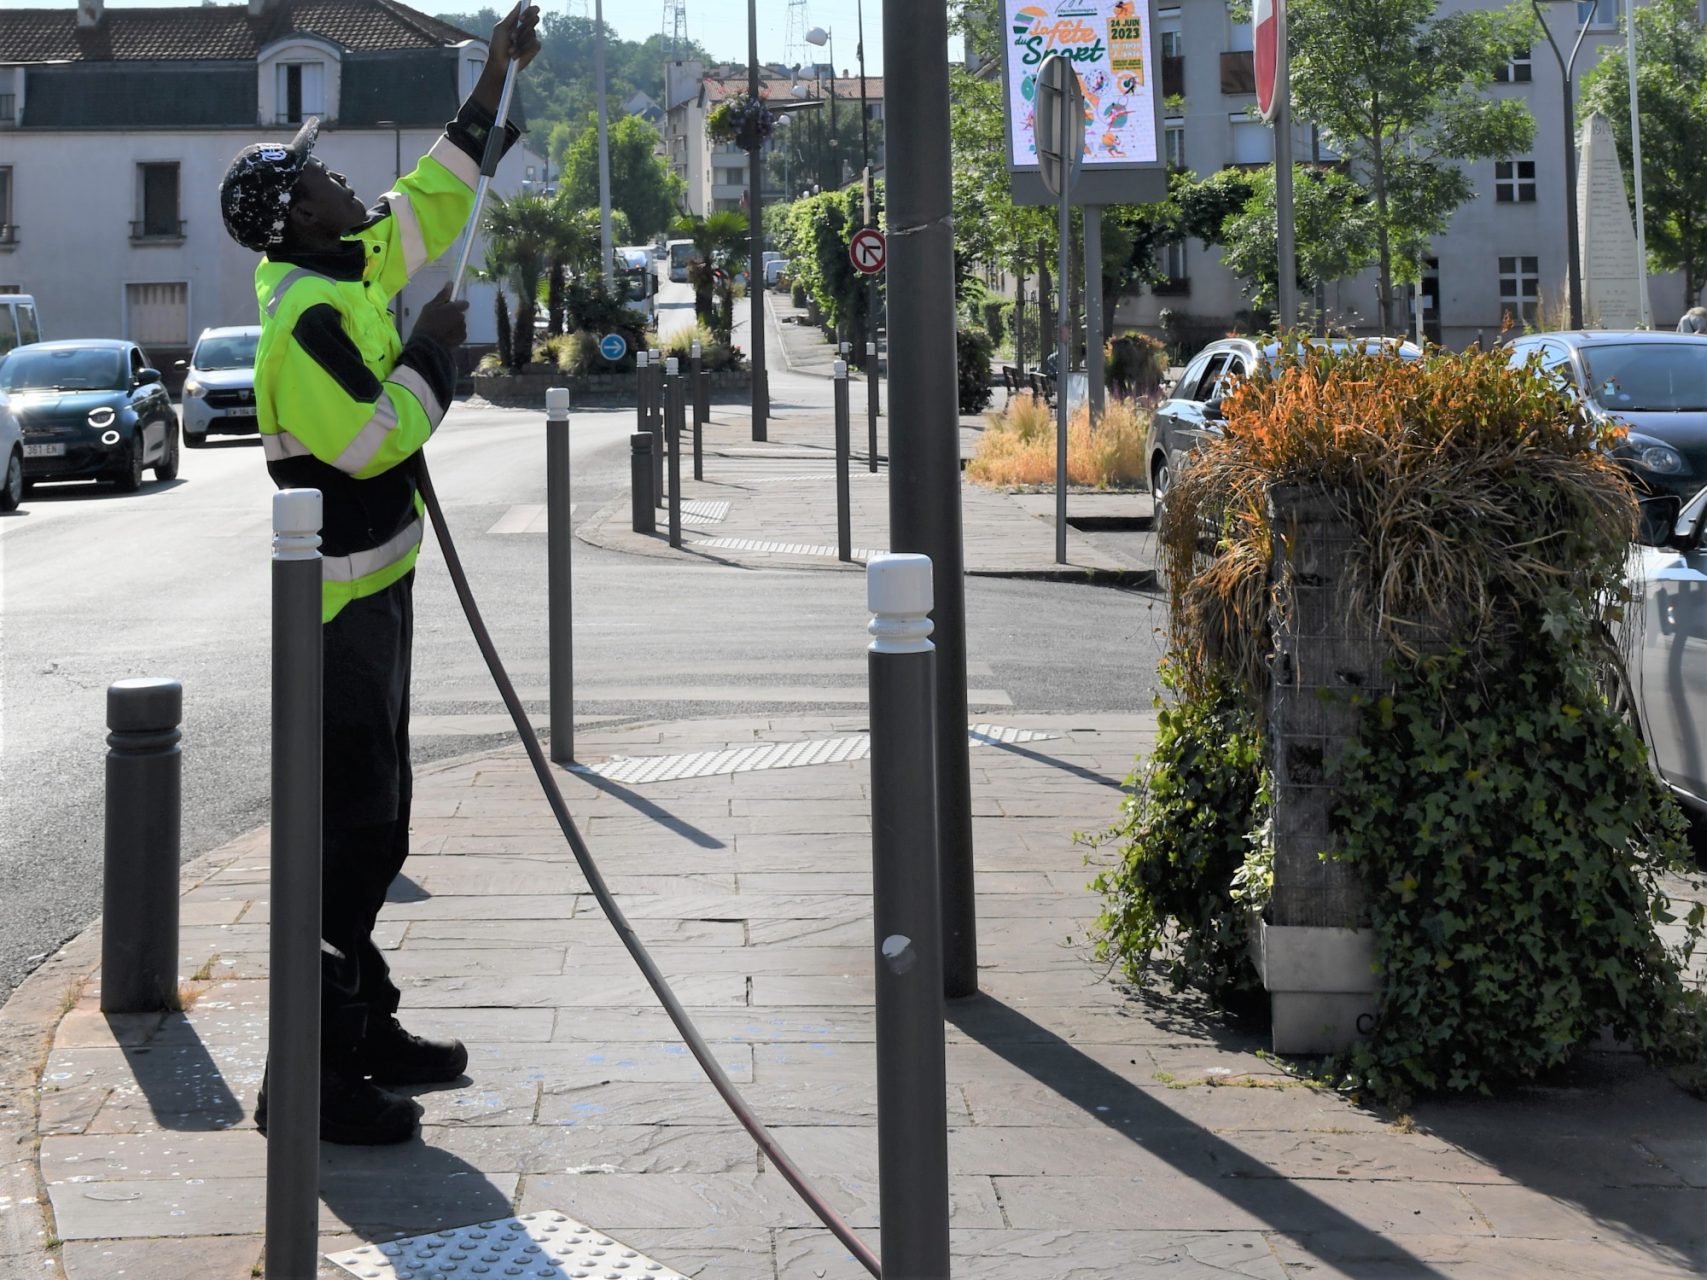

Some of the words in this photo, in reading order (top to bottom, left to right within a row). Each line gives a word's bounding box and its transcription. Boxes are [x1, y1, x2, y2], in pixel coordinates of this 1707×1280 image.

[1111, 19, 1120, 27] 24
[1122, 18, 1140, 26] JUIN
[1111, 27, 1140, 39] 2023
[1014, 36, 1027, 45] du
